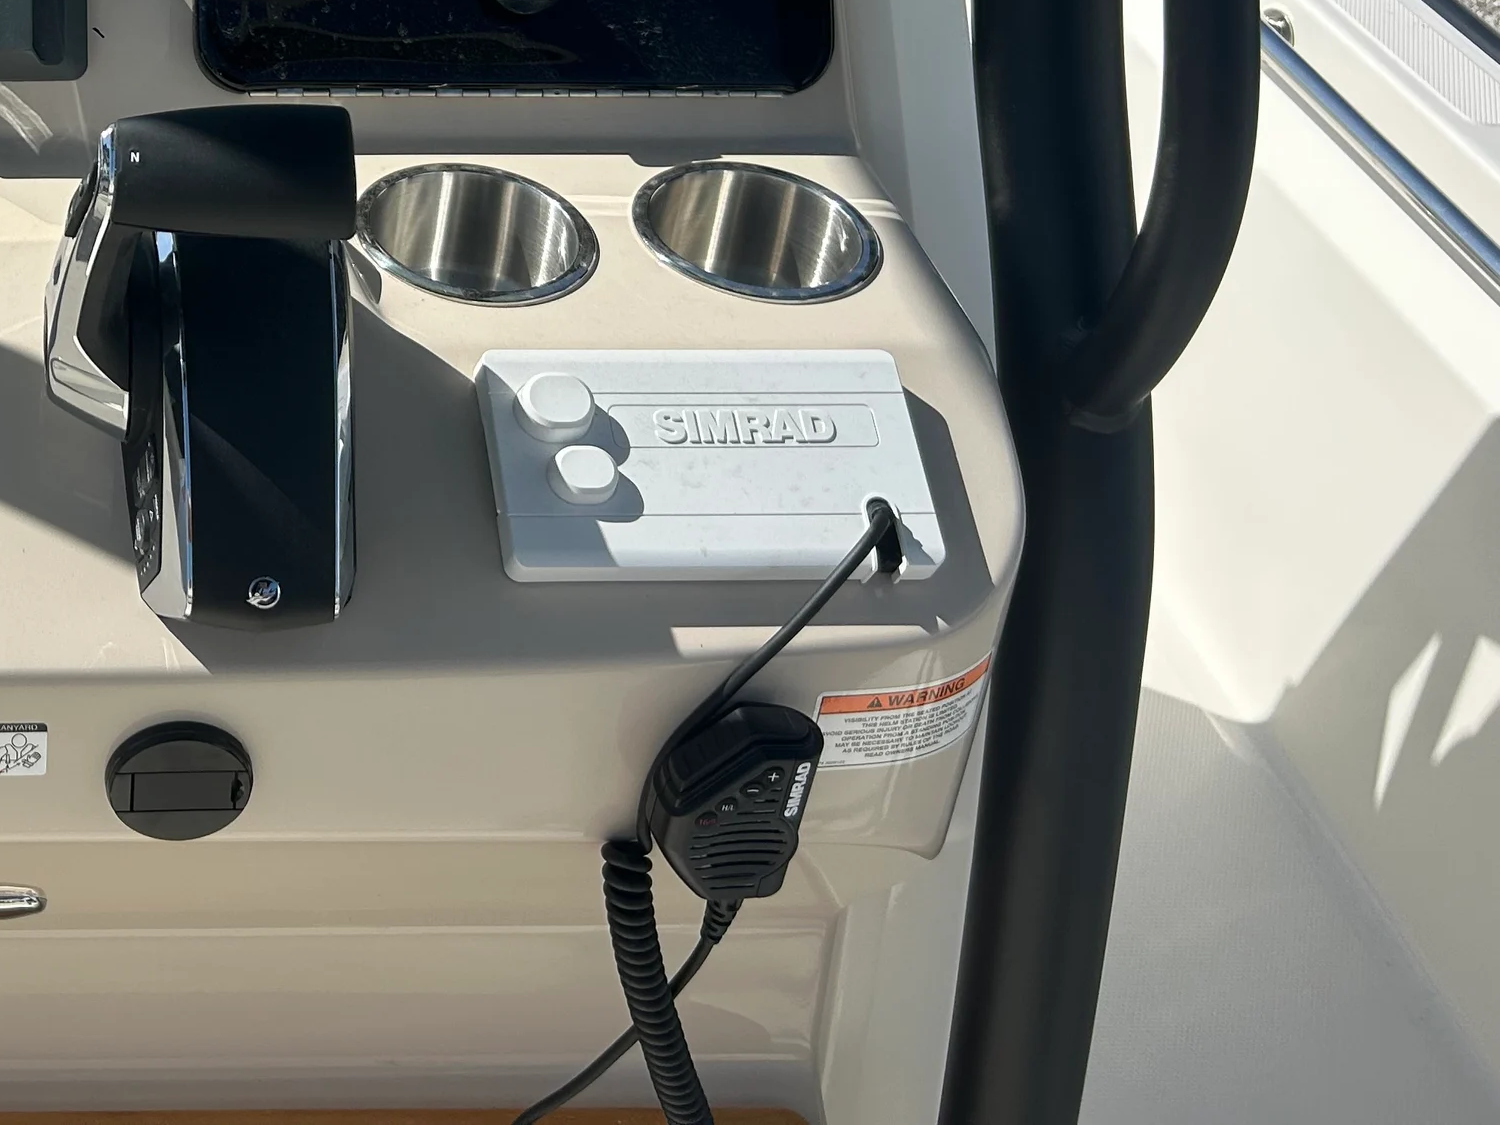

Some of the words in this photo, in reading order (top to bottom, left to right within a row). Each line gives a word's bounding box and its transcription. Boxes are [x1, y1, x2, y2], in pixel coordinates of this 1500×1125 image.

[130, 151, 141, 163] N
[653, 408, 838, 445] SIMRAD
[888, 678, 966, 706] WARNING
[783, 761, 812, 817] SIMRAD
